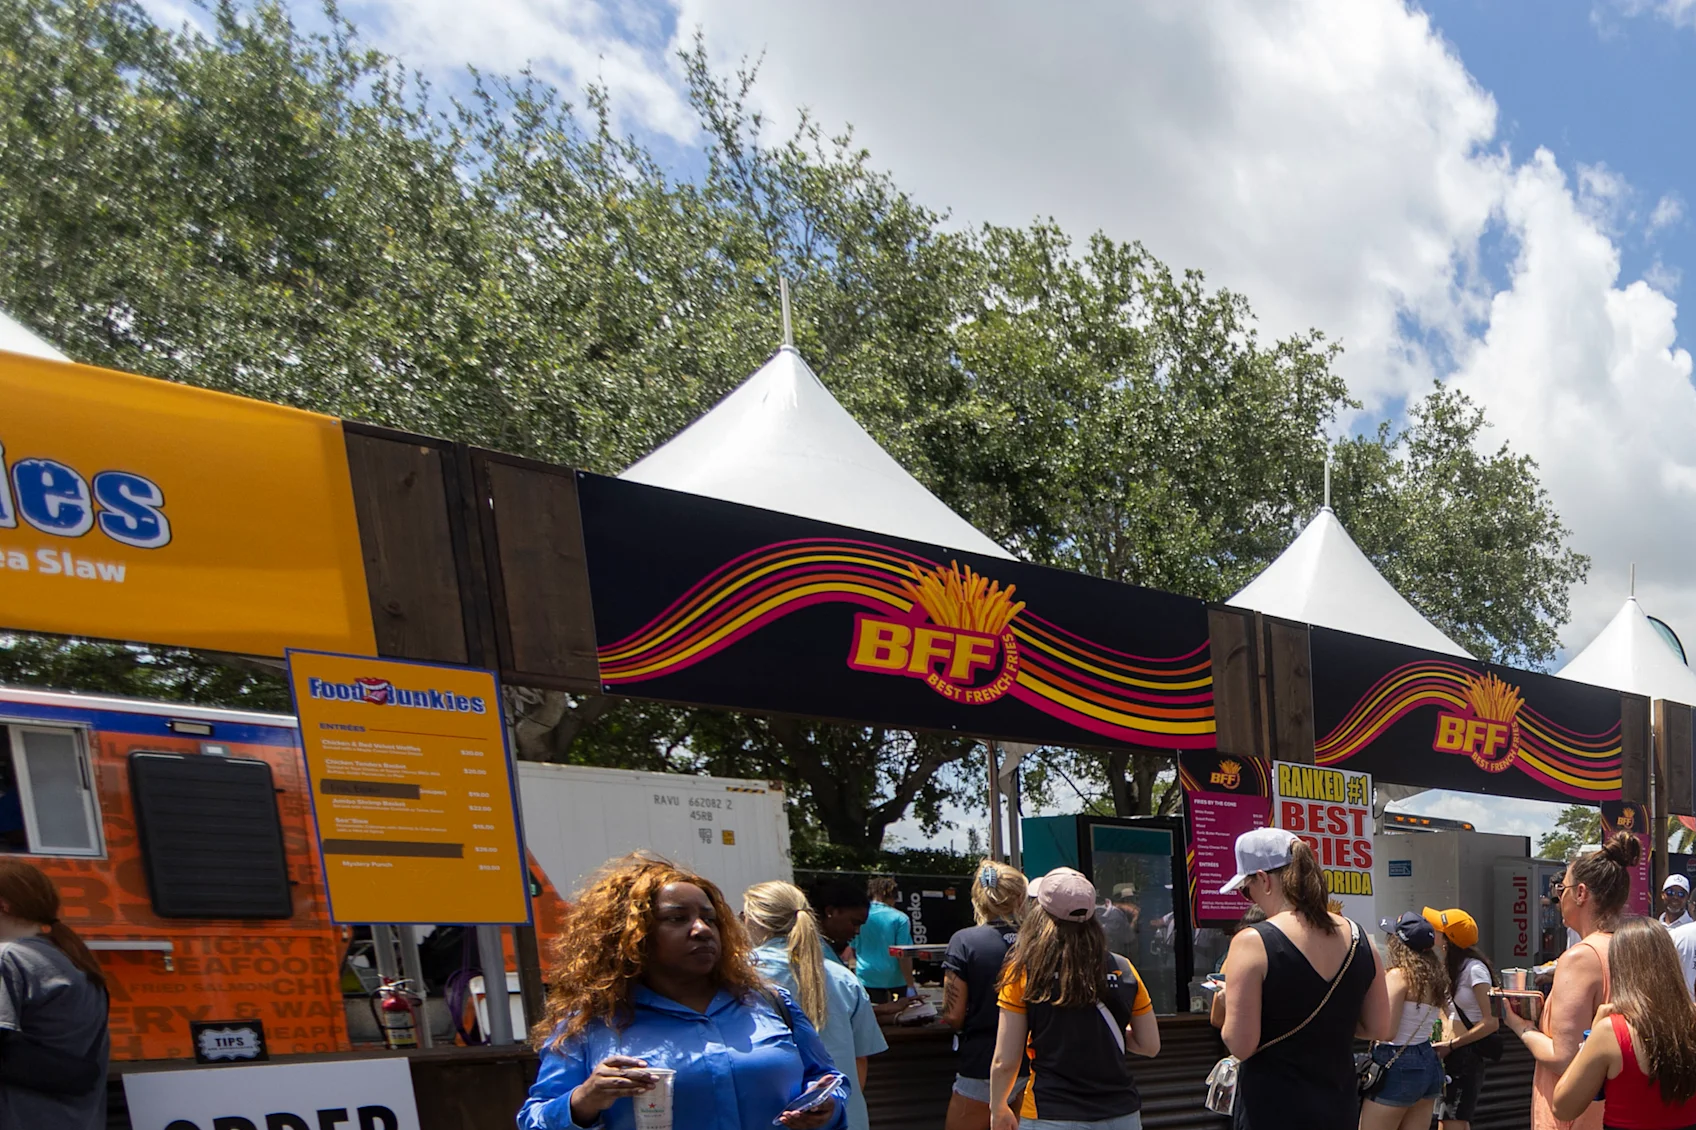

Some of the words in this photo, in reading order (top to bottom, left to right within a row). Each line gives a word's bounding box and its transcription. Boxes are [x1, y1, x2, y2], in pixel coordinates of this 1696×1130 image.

[36, 549, 126, 582] Slaw
[853, 617, 995, 680] BFF
[927, 672, 962, 699] BEST
[965, 672, 1014, 702] FRENCH
[1002, 633, 1018, 672] FRIES
[308, 677, 369, 703] Food
[386, 685, 487, 715] Junkies
[1436, 715, 1508, 755] BFF
[1471, 751, 1490, 770] BEST
[1490, 749, 1517, 771] FRENCH
[1511, 721, 1519, 749] FRIES
[1210, 772, 1236, 785] BFF
[1279, 763, 1345, 803] RANKED
[1346, 775, 1369, 806] #1
[653, 794, 680, 806] RAVU
[726, 799, 733, 810] 2
[1281, 801, 1368, 837] BEST
[1298, 834, 1373, 870] RIES
[1324, 869, 1373, 896] ORIDA
[1512, 876, 1528, 914] Bull
[907, 892, 928, 945] ggreko
[1513, 917, 1528, 957] Red
[150, 956, 334, 976] SEAFOOD
[130, 983, 185, 994] FRIED
[192, 982, 272, 993] SALMON
[215, 1036, 244, 1047] TIPS
[267, 1026, 344, 1040] EAPP
